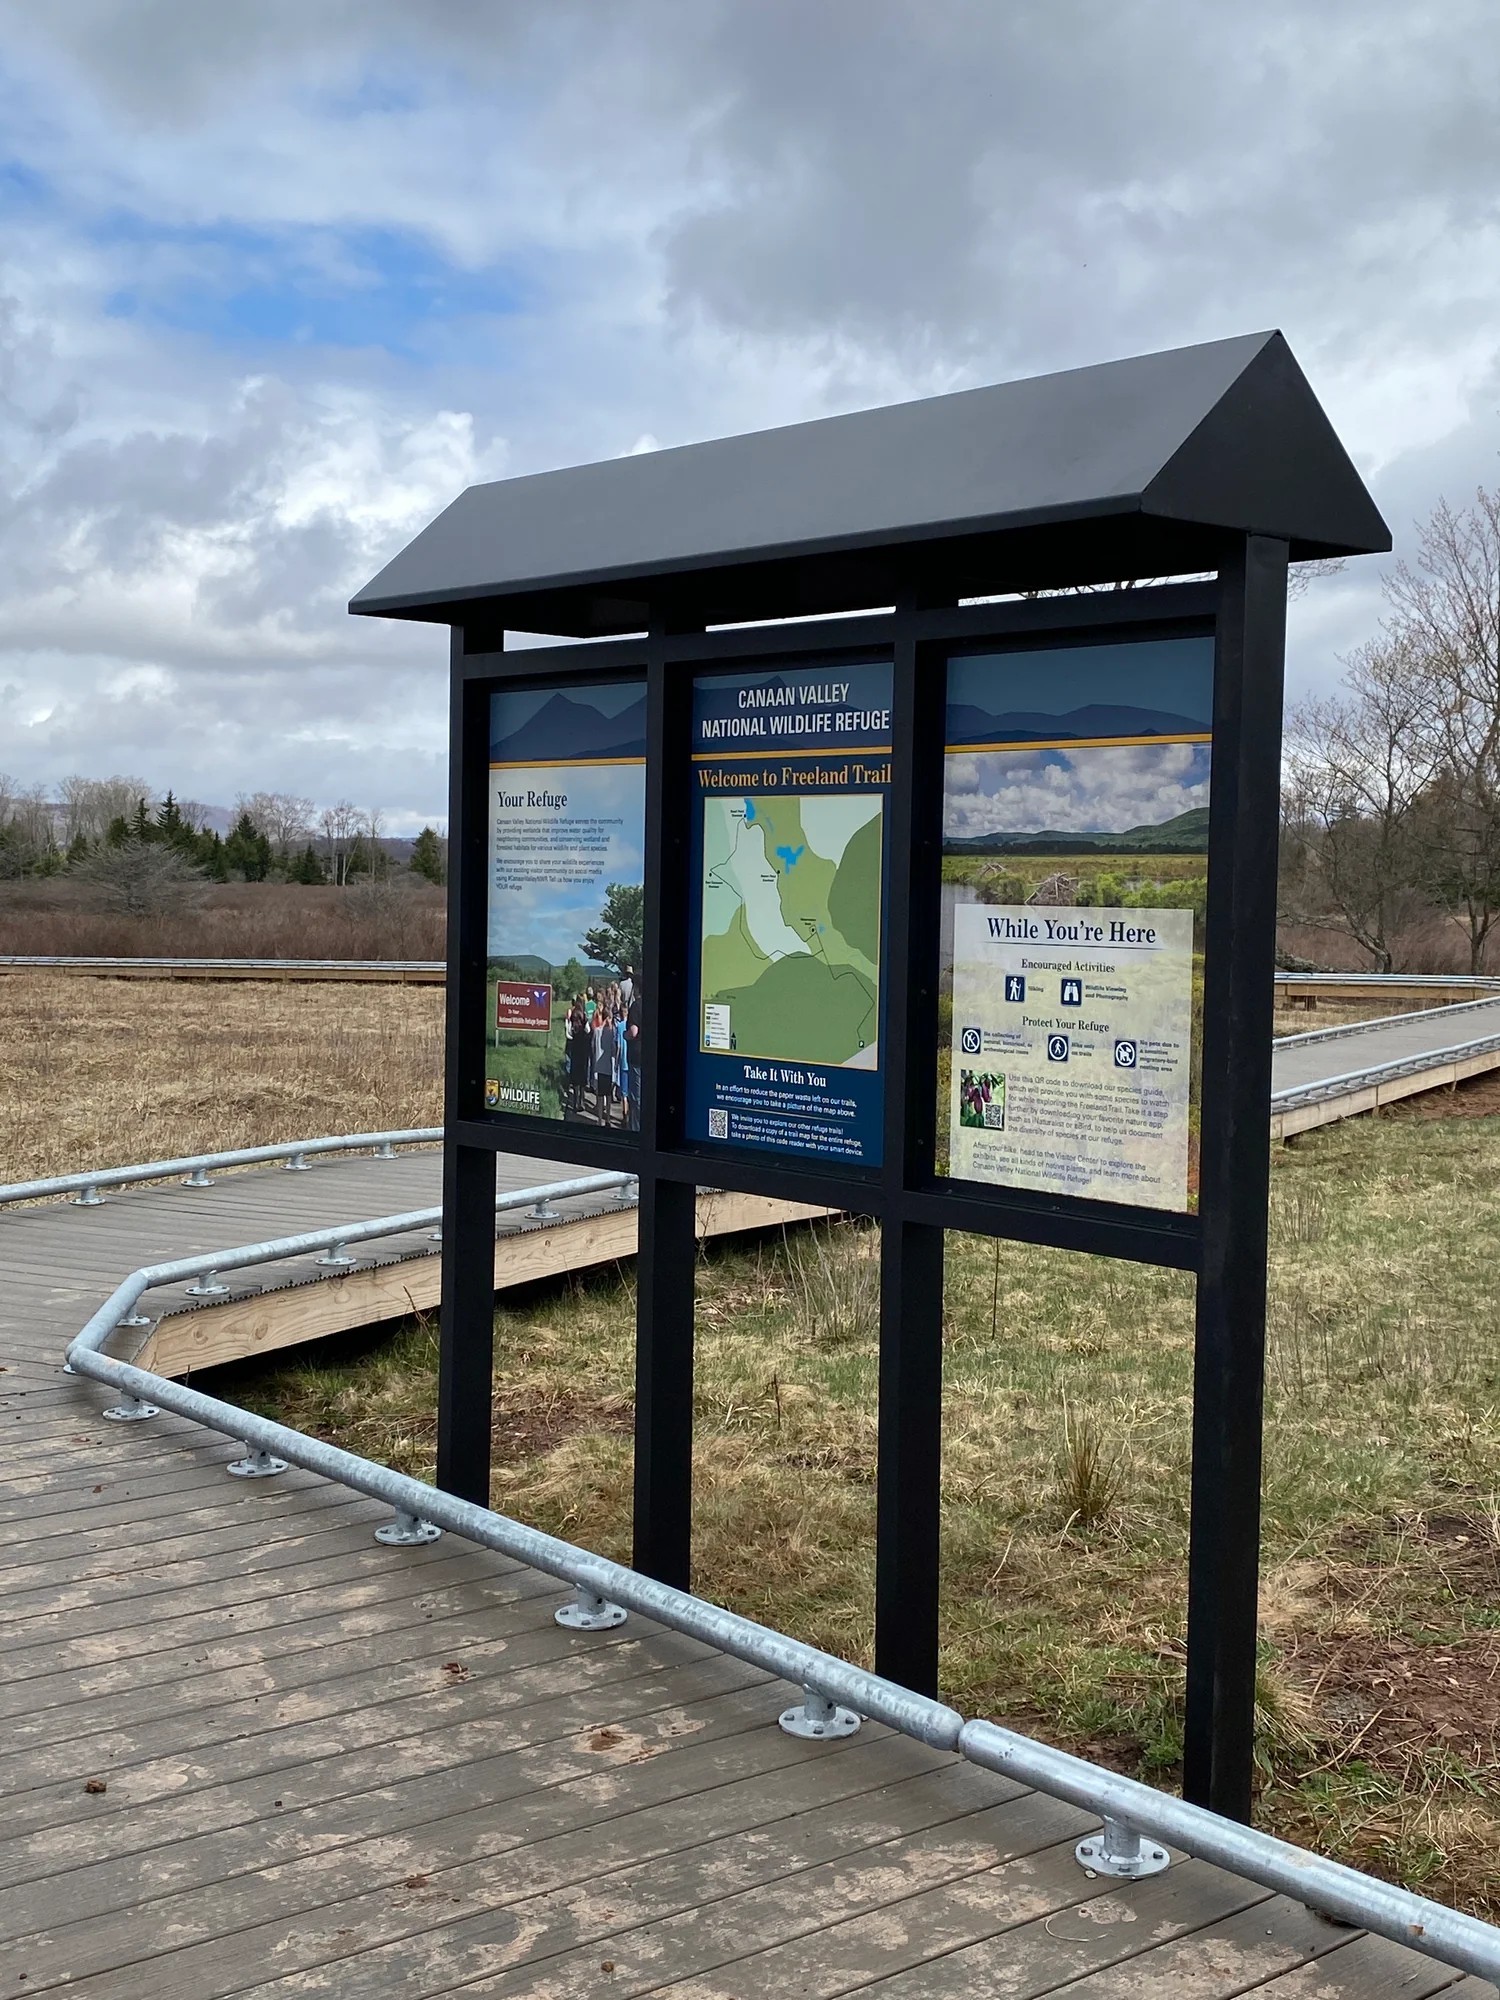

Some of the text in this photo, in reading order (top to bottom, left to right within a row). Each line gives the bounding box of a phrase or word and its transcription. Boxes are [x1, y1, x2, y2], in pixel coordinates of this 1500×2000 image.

[739, 683, 849, 708] CANAAN VALLEY
[702, 710, 889, 738] NATIONAL WILDLIFE REFUGE
[699, 764, 891, 787] Welcome to Freeland Trail
[497, 791, 567, 810] Your Refuge
[987, 917, 1155, 943] While You're Here
[1021, 958, 1115, 973] Encouraged Activities
[500, 994, 530, 1006] Welcome
[1022, 1016, 1109, 1032] Protect Your Refuge
[731, 1039, 736, 1050] N
[744, 1065, 826, 1087] Take It With You
[500, 1088, 539, 1104] WILDLIFE
